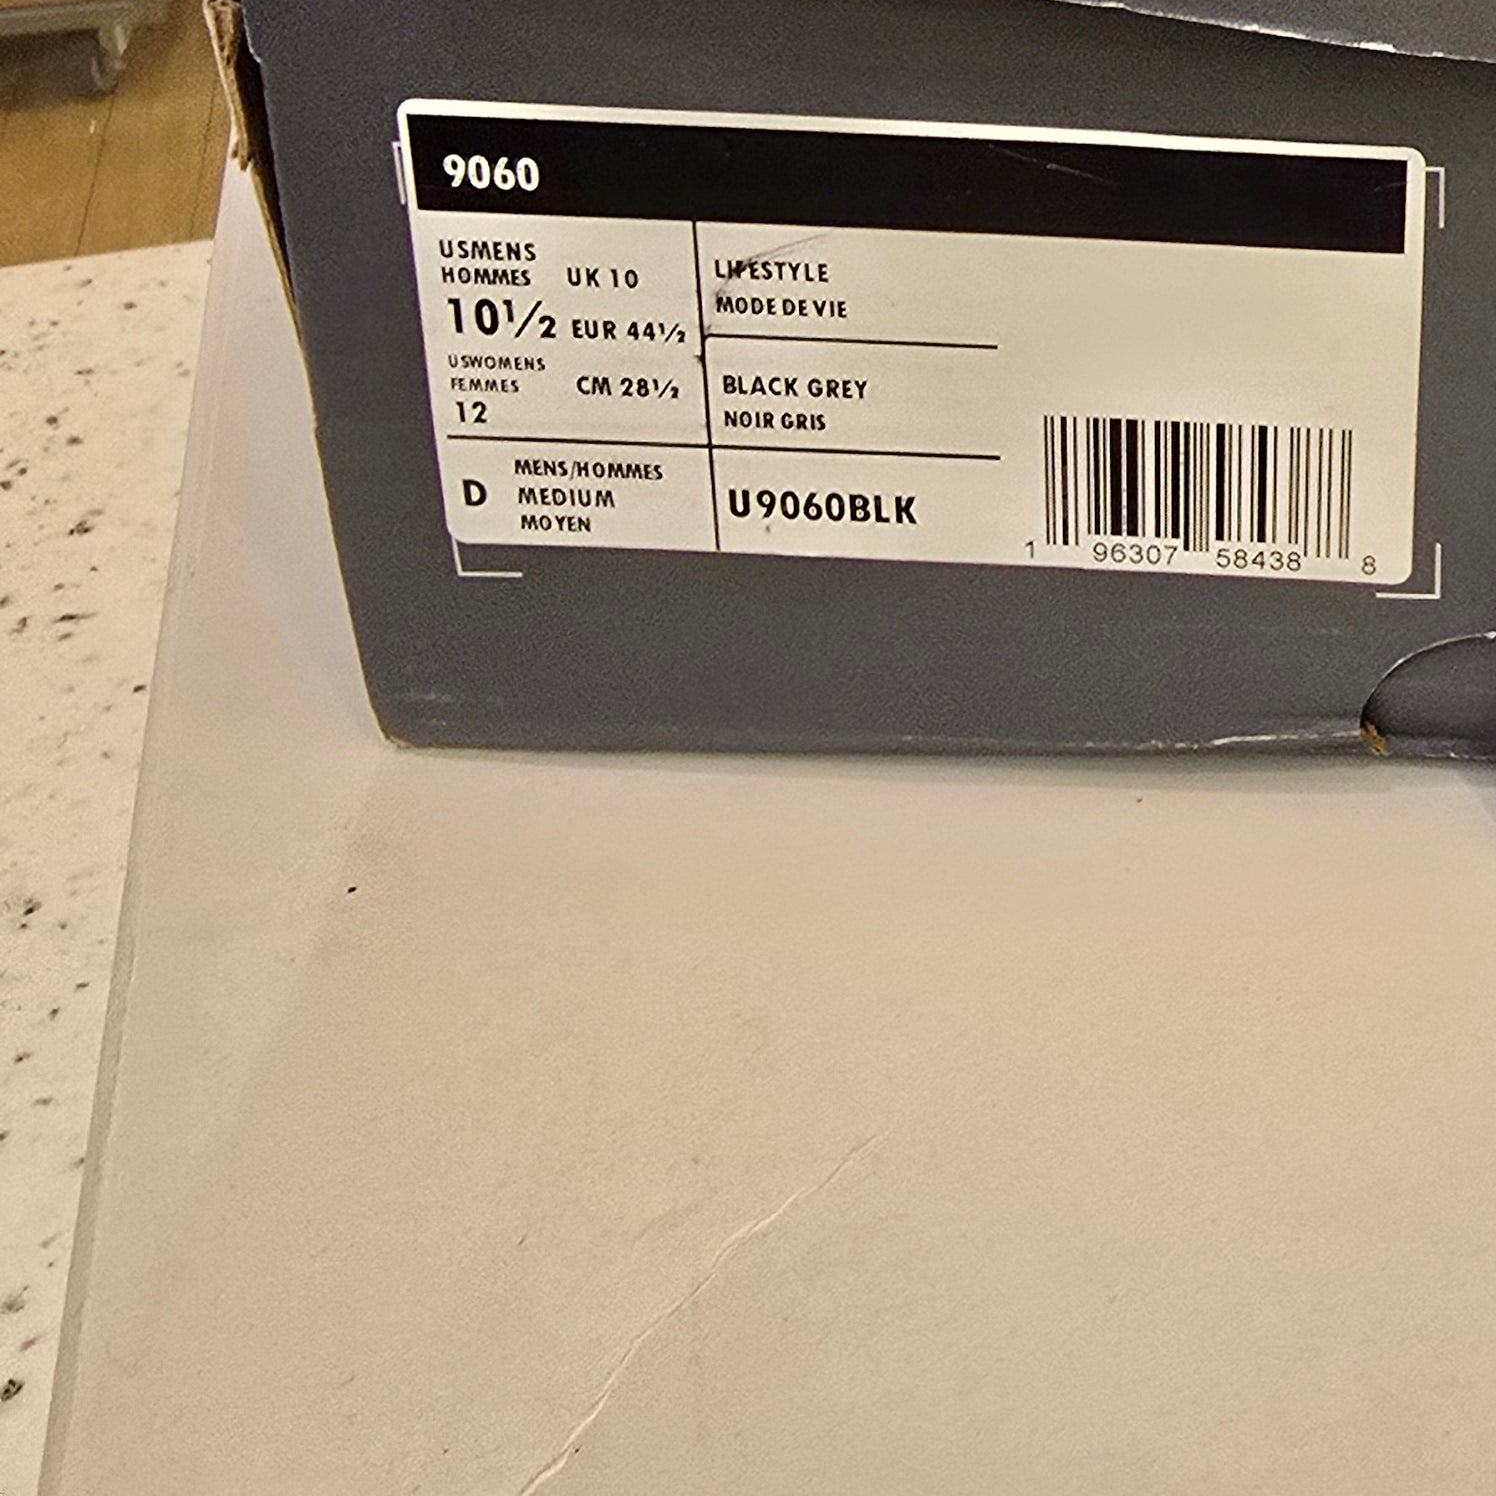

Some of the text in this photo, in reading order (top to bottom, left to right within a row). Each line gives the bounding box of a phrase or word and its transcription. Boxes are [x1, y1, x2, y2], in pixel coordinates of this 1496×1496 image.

[442, 154, 540, 192] 9060
[441, 267, 531, 287] HOMMES
[567, 267, 639, 289] UK 10
[714, 259, 829, 283] LIFESTYLE
[715, 296, 848, 318] MODE DE VIE
[572, 319, 616, 340] EUR
[451, 377, 520, 394] FEMMES
[576, 376, 612, 397] CM
[723, 375, 867, 400] BLACK GREY
[456, 401, 488, 424] 12
[724, 410, 827, 432] NOIR GRIS
[514, 459, 664, 481] MENS/HOMMES
[462, 479, 488, 507] D
[518, 487, 616, 509] MEDIUM
[728, 489, 918, 525] U9060BLK
[520, 514, 592, 533] MOYEN
[1024, 540, 1378, 577] 1 96307 58438 8
